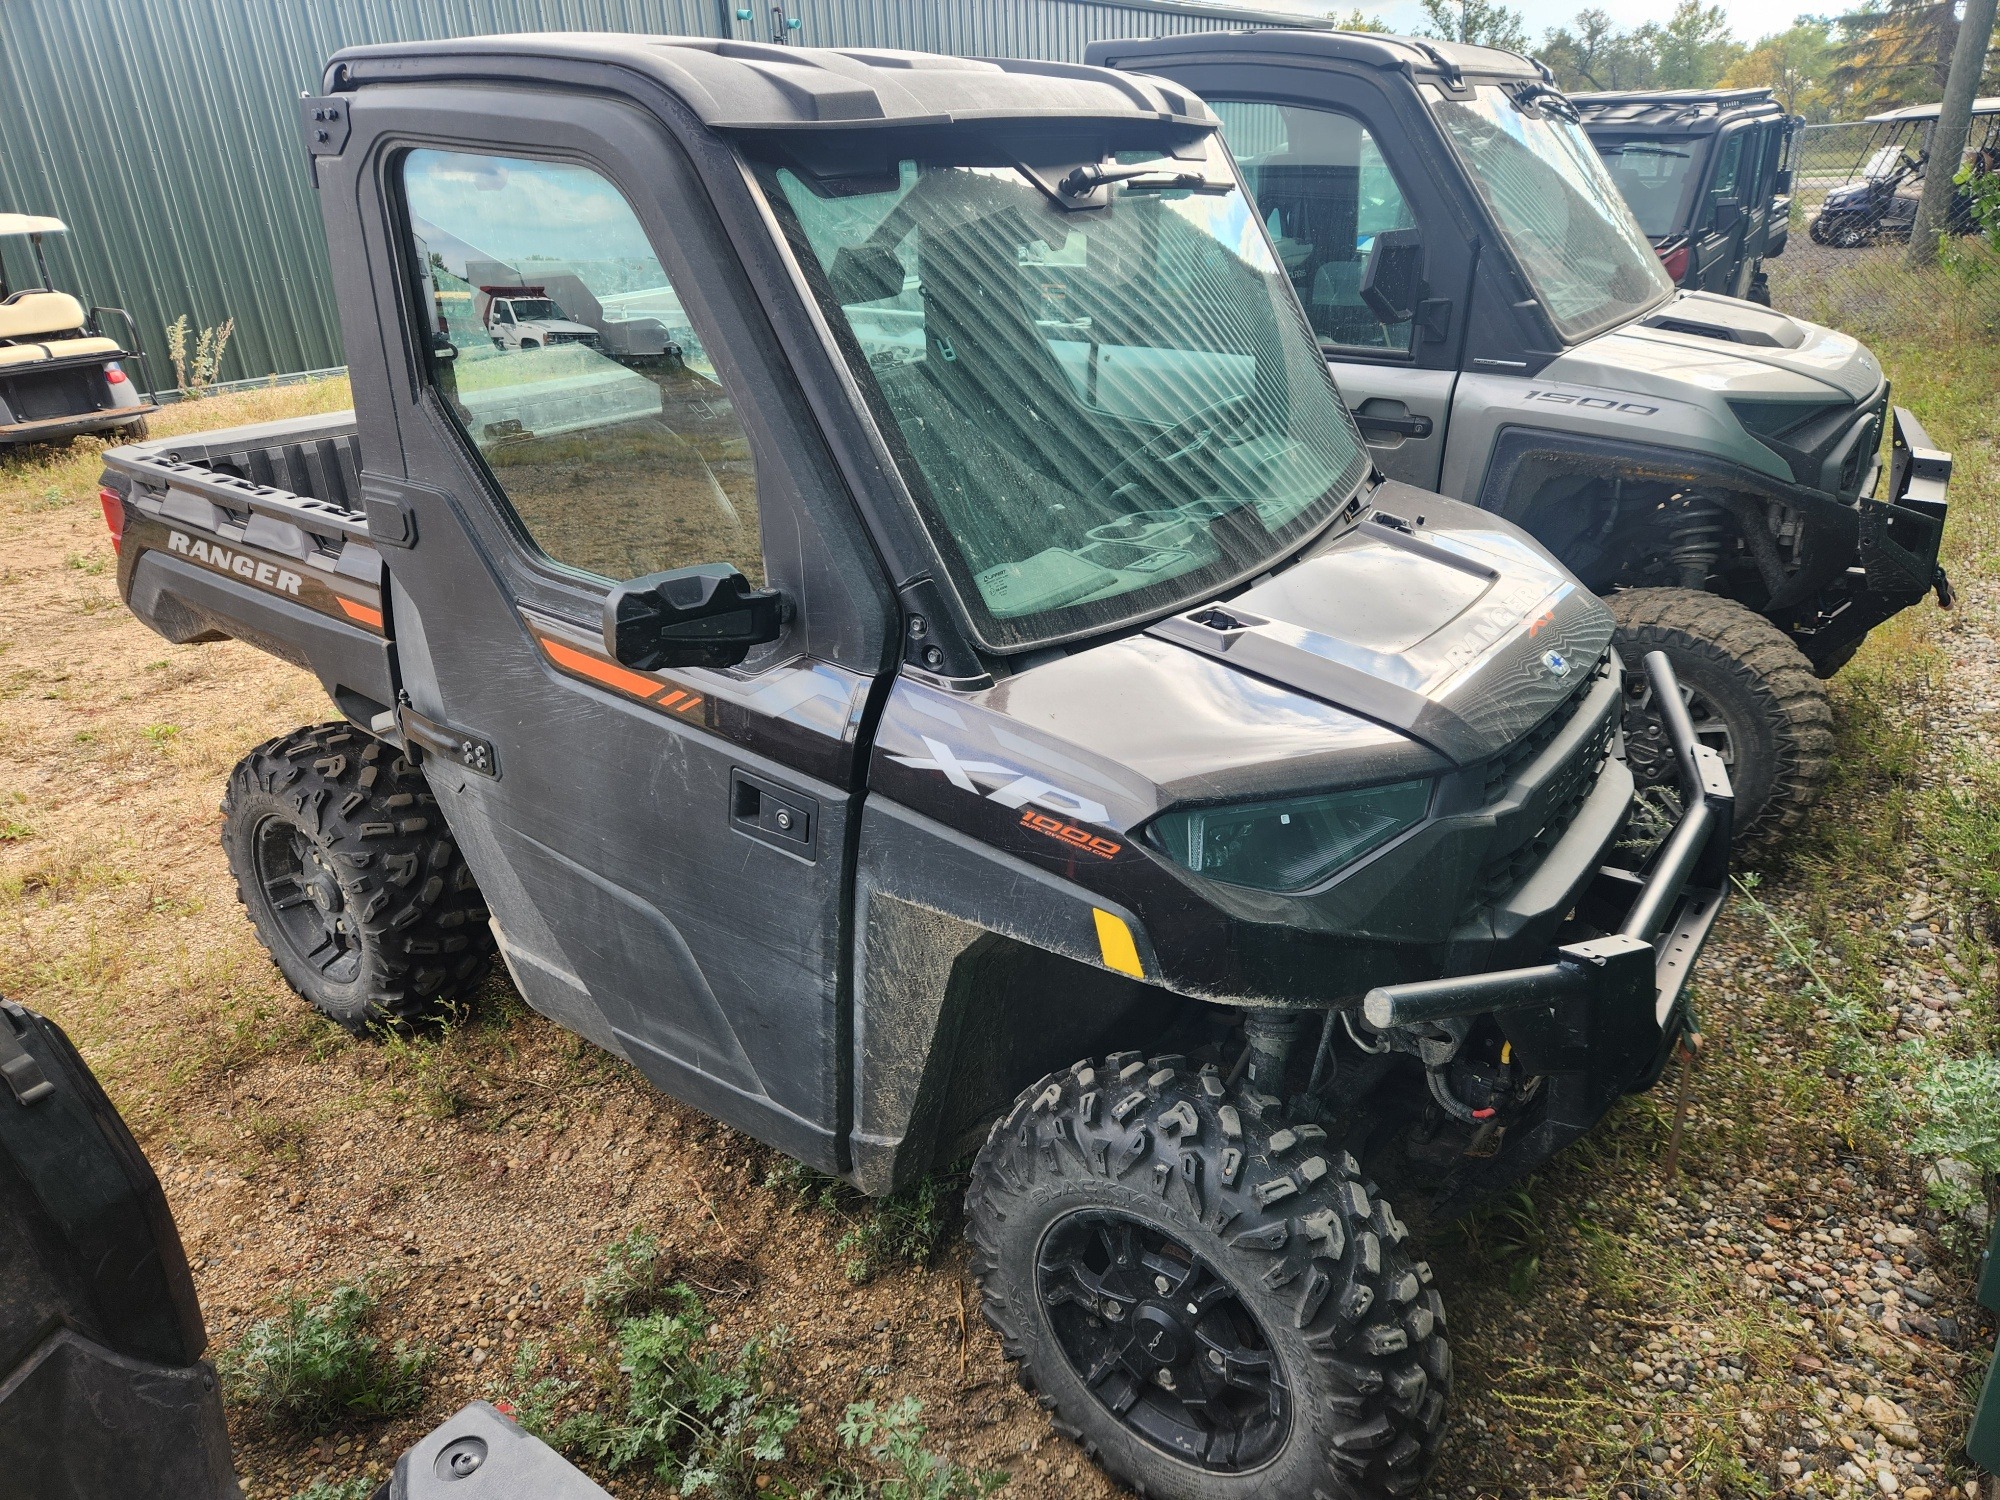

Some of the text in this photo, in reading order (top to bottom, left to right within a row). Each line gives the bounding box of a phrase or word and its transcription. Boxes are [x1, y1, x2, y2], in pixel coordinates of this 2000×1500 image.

[1524, 390, 1660, 416] 1500
[167, 530, 303, 596] RANGER
[1443, 585, 1542, 673] RANGER
[884, 734, 1110, 822] XP
[1022, 810, 1121, 855] 1000
